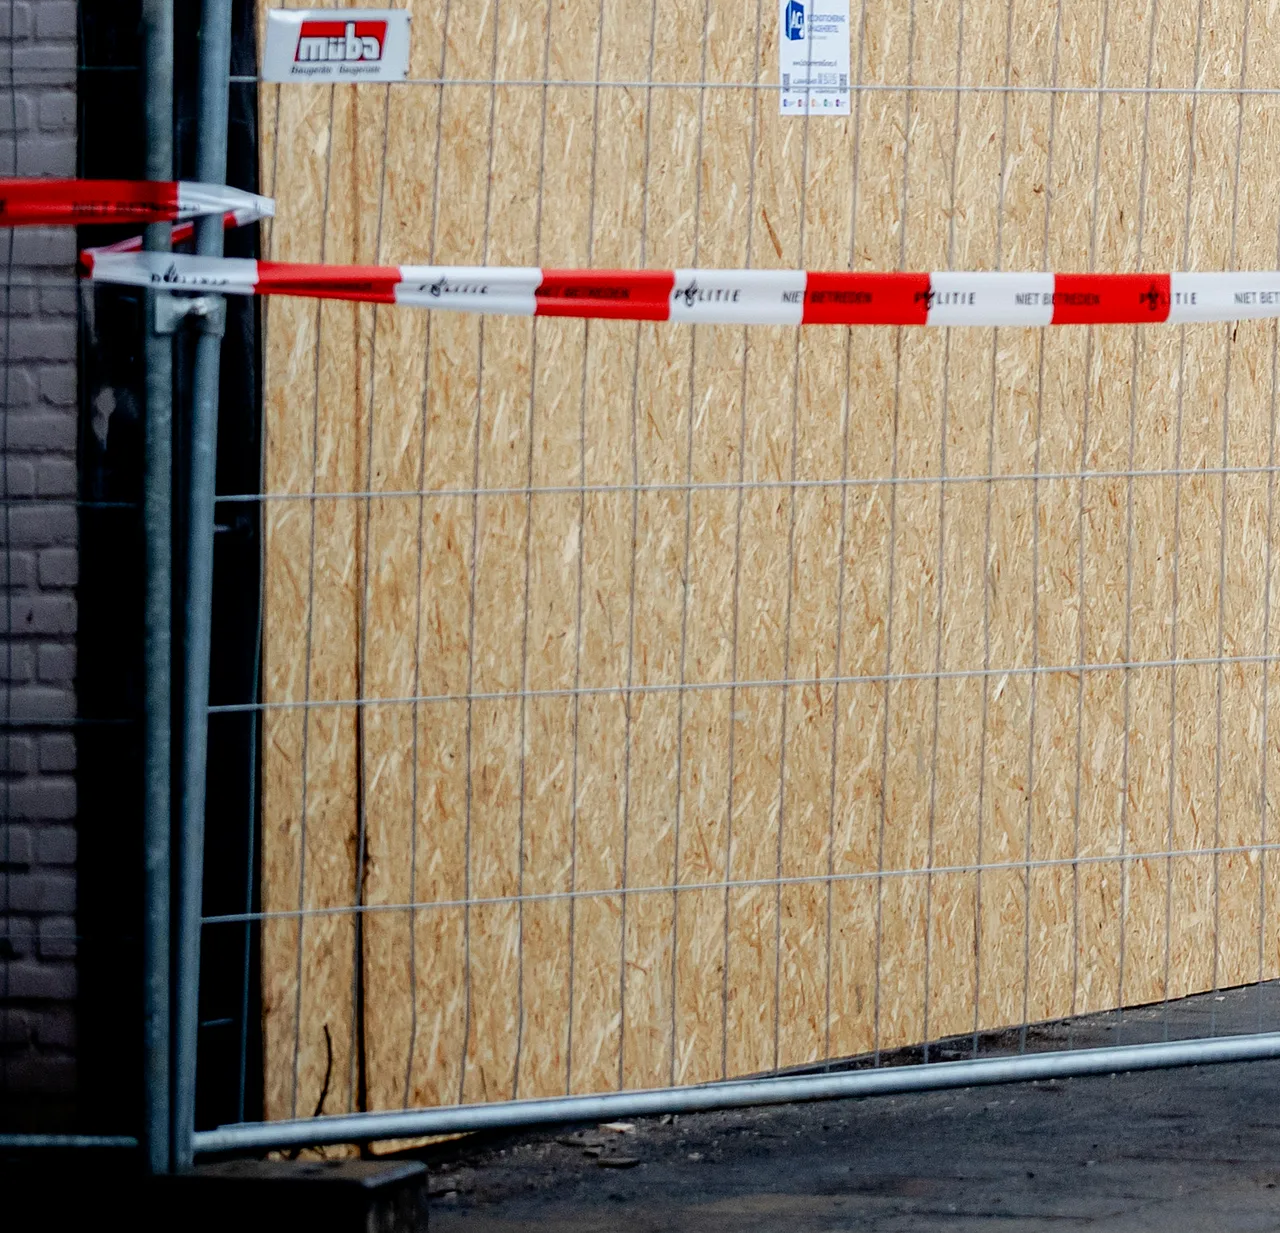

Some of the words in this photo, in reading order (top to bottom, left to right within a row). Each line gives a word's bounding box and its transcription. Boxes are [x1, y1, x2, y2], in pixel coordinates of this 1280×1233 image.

[298, 22, 381, 61] müba
[674, 280, 740, 308] POLITIE
[782, 291, 806, 305] NIET
[810, 291, 873, 304] BETREDEN
[914, 284, 976, 311] POLITIE
[1015, 293, 1040, 306] NIET
[1042, 293, 1100, 306] BETREDEN
[1139, 284, 1198, 311] POLITIE
[1234, 292, 1257, 305] NIET
